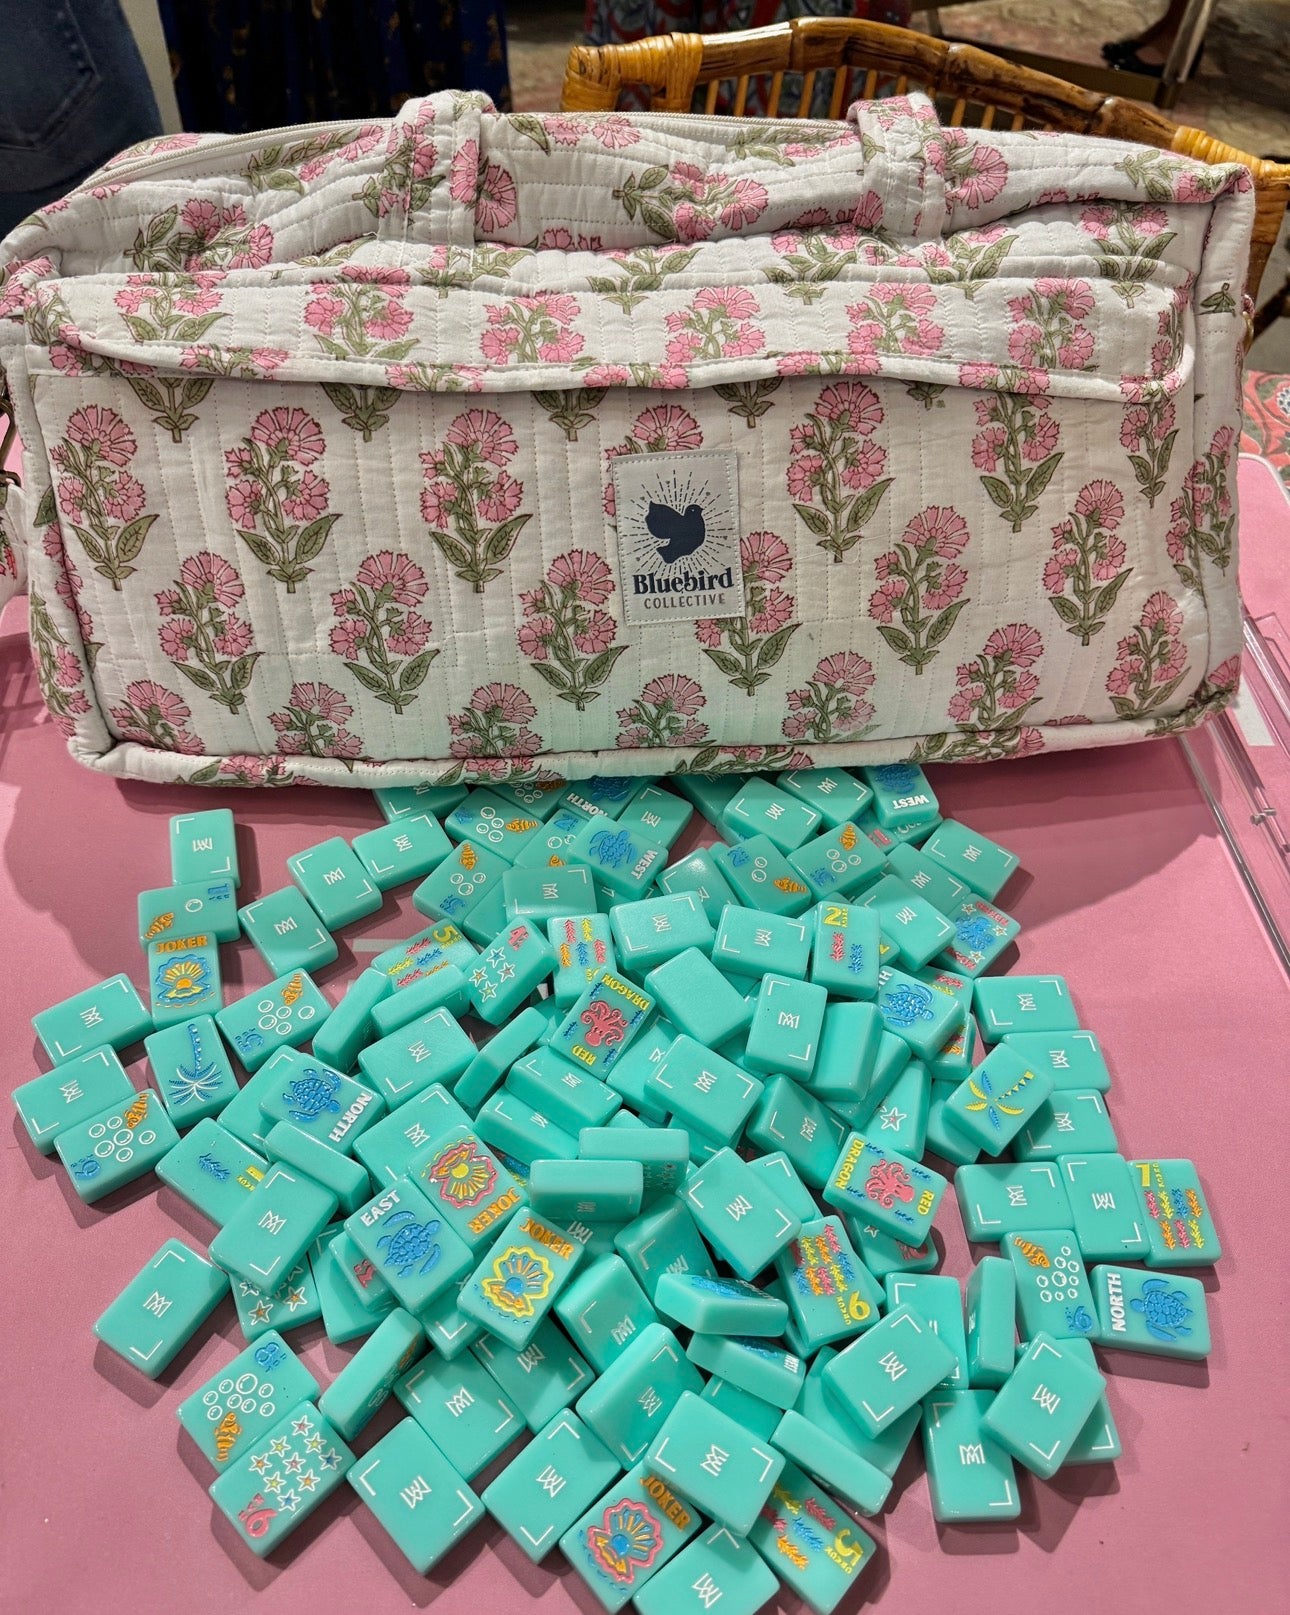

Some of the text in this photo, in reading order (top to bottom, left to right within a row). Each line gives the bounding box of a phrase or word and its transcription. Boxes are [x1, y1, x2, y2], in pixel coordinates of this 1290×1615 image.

[632, 567, 735, 595] Bluebird
[643, 593, 727, 610] COLLECTIVE
[892, 795, 930, 809] WEST
[630, 850, 659, 879] WEST
[823, 905, 842, 926] 2
[155, 935, 208, 954] JOKER
[433, 925, 458, 942] 5
[508, 925, 527, 945] 4
[601, 973, 650, 1011] DRAGON
[571, 1044, 597, 1066] RED
[328, 1092, 374, 1142] NORTH
[834, 1138, 865, 1190] DRAGON
[1135, 1163, 1150, 1187] 7
[360, 1188, 401, 1227] EAST
[467, 1186, 521, 1234] JOKER
[916, 1189, 935, 1215] RED
[518, 1217, 575, 1261] JOKER
[1106, 1272, 1127, 1332] NORTH
[255, 1342, 280, 1367] 8
[640, 1474, 692, 1532] JOKER
[835, 1528, 864, 1567] 5
